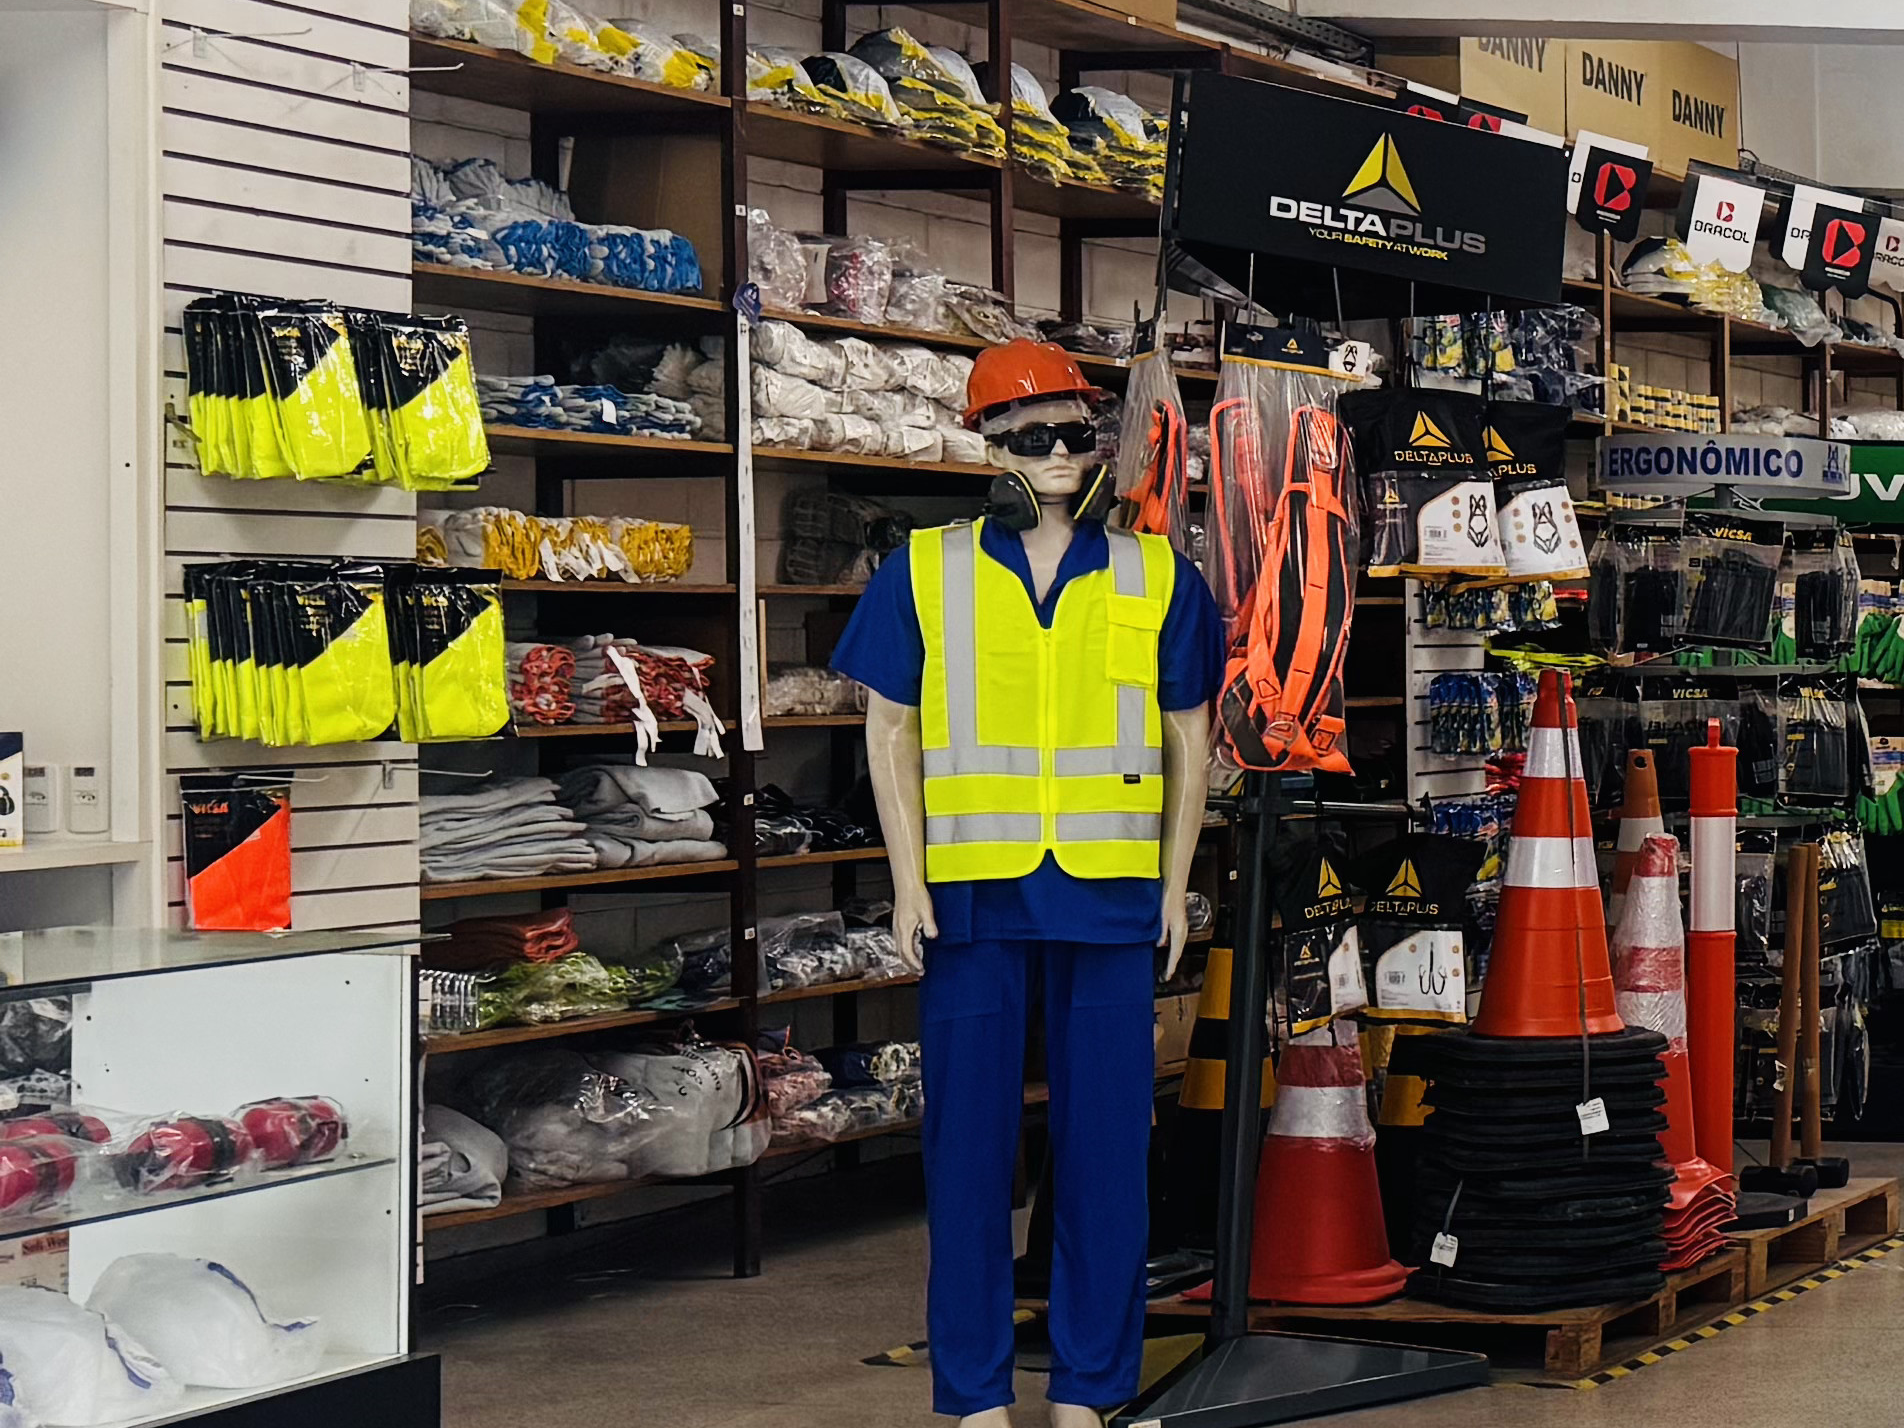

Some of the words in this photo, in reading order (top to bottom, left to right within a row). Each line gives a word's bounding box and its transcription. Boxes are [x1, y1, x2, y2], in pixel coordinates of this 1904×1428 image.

[1582, 51, 1645, 106] DANNY
[1672, 89, 1725, 139] DANNY
[1269, 195, 1487, 255] DELTAPLUS
[1694, 220, 1750, 244] BRACOL
[1309, 226, 1343, 241] YOUR
[1408, 246, 1449, 261] WORK
[1394, 450, 1474, 465] DELTAPLUS
[1608, 441, 1804, 479] ERGONÔMICO
[1715, 527, 1752, 541] VICSA
[1672, 688, 1709, 700] VICSA
